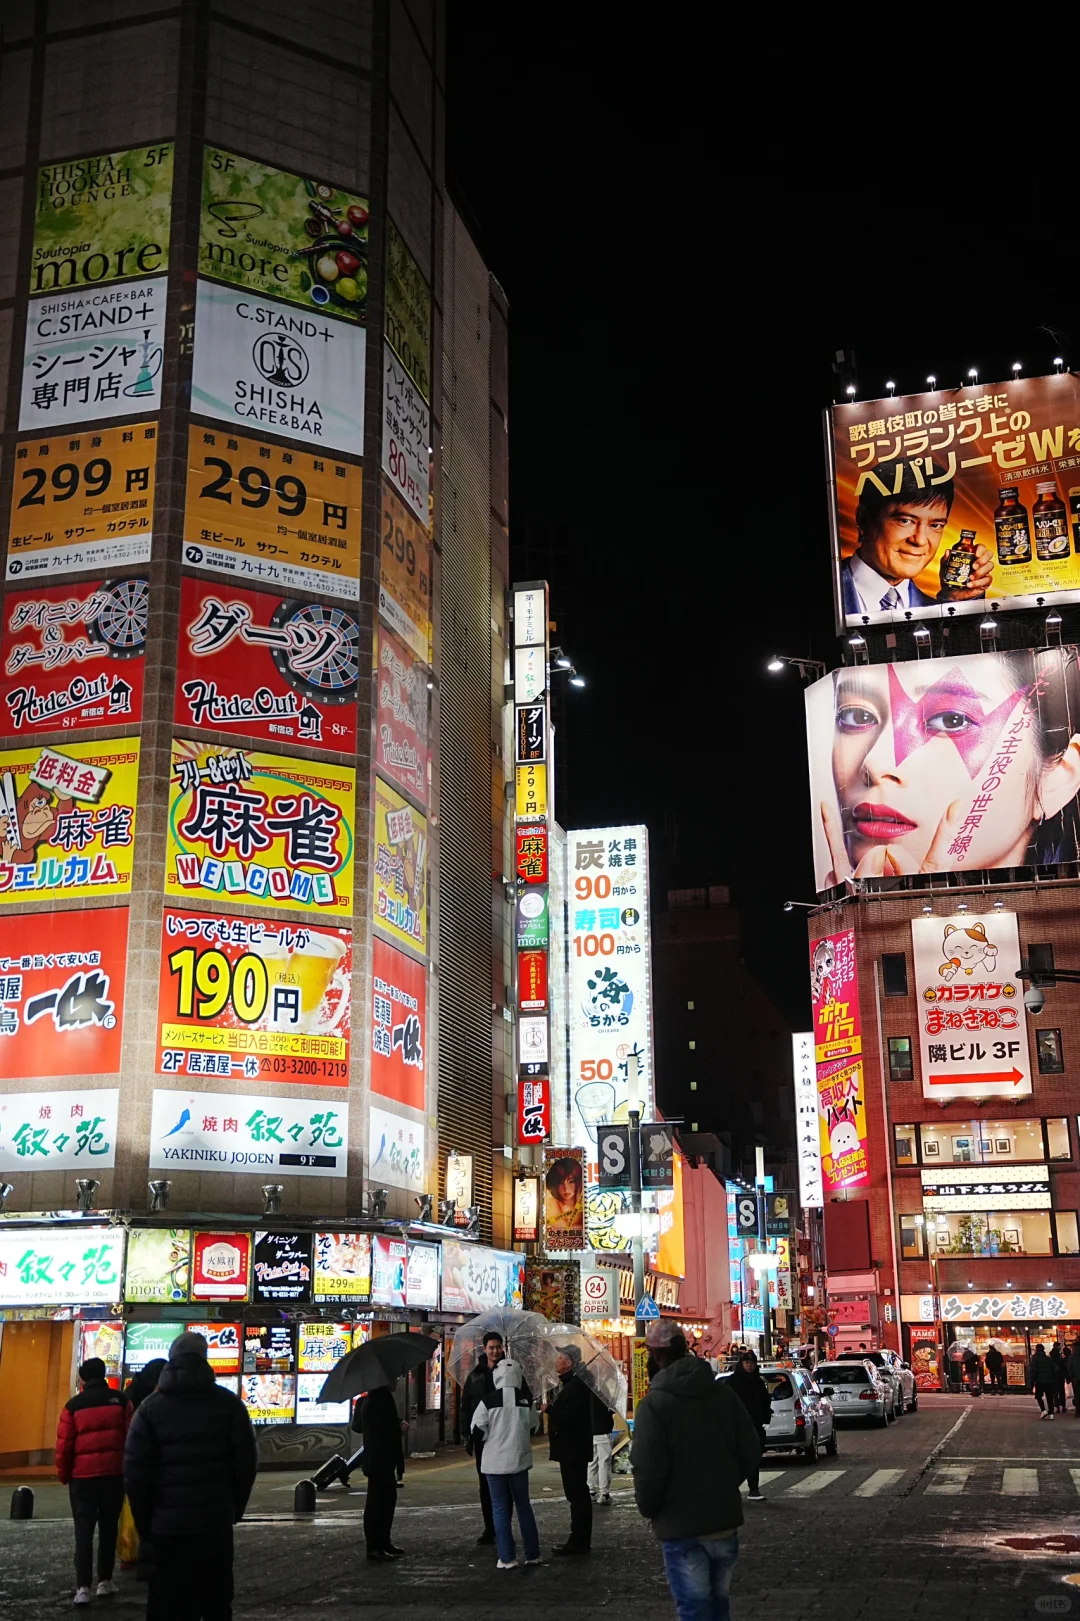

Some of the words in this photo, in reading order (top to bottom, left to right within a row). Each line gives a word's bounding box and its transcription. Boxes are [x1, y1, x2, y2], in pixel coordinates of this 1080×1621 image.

[41, 156, 115, 184] SHISHA
[144, 147, 169, 167] 5F
[210, 154, 235, 173] 5F
[39, 183, 131, 212] LOUNGE
[40, 168, 131, 198] HOOKAH
[34, 241, 90, 260] Suutopia
[245, 233, 290, 255] Suutopia
[31, 243, 162, 292] more
[206, 242, 289, 282] more
[37, 302, 154, 337] C.STAND+
[236, 303, 334, 343] C.STAND+
[32, 346, 136, 379] シーシャ
[30, 373, 123, 410] 専門店
[236, 381, 323, 419] SHISHA
[387, 363, 427, 428] ハイボール
[234, 402, 323, 436] CAFE&BAR
[387, 382, 428, 450] レモンサワー
[848, 393, 1008, 442] 歌舞伎町の皆さまに
[122, 428, 155, 443] 料理
[850, 410, 1031, 468] ワンランク上の
[204, 433, 238, 451] 焼鳥
[259, 447, 293, 464] 刺身
[313, 460, 346, 478] 料理
[1005, 465, 1049, 481] 清涼飲料水
[12, 533, 53, 547] 生ビール
[65, 527, 95, 538] サワー
[107, 518, 148, 532] カクテル
[277, 525, 347, 549] 均一個室居酒屋
[52, 553, 83, 566] 九十九
[188, 548, 201, 561] 7F
[201, 530, 245, 547] 生ビール
[257, 542, 288, 555] サワー
[300, 552, 341, 569] カクテル
[11, 563, 21, 572] 7F
[241, 560, 279, 578] 九十九
[304, 580, 356, 597] 03-6302-1914
[11, 593, 109, 630] ダイニング
[190, 599, 341, 669] ダーツ
[6, 640, 108, 672] ダーツバー
[62, 717, 77, 727] 8F
[332, 724, 348, 735] 8F
[528, 708, 542, 748] ダーツ
[36, 755, 96, 796] 低料金
[947, 663, 1059, 862] わたしが主役の世界線。
[50, 808, 131, 849] 麻雀
[184, 786, 338, 865] 麻雀
[375, 843, 404, 897] 麻雀
[518, 837, 545, 877] 麻雀
[575, 840, 605, 871] 炭
[0, 855, 117, 889] ウェルカム
[178, 858, 328, 898] WELCOME
[517, 877, 525, 885] 6F
[517, 889, 525, 897] 5F
[378, 888, 422, 943] ウェルカム
[574, 907, 620, 931] 寿司
[167, 916, 310, 949] いつでも生ビールが
[517, 936, 548, 947] more
[28, 972, 111, 1027] 一休
[587, 967, 630, 1004] 海
[937, 983, 1002, 1002] カラオケ
[589, 1013, 629, 1027] ちから
[819, 997, 849, 1024] ポケ
[926, 1006, 1019, 1034] まねきねこ
[393, 1014, 422, 1065] 一休
[825, 1016, 854, 1041] パラ
[163, 1052, 184, 1070] 2F
[189, 1053, 258, 1075] 居酒屋一休
[274, 1060, 347, 1077] 03-3200-1219
[928, 1042, 986, 1063] 隣ビル
[992, 1041, 1020, 1059] 3F
[528, 1064, 540, 1073] 3F
[821, 1076, 859, 1108] 高収入
[39, 1104, 83, 1119] 焼肉
[202, 1116, 238, 1132] 焼肉
[523, 1104, 544, 1137] 一休
[827, 1096, 862, 1126] バイト
[12, 1117, 109, 1156] 叙々苑
[245, 1110, 343, 1147] 叙々苑
[163, 1148, 227, 1161] YAKINIKU
[231, 1152, 274, 1165] JOJOEN
[300, 1155, 316, 1166] 9F
[940, 1184, 1048, 1194] 山下本気うどん
[16, 1244, 118, 1285] 叙々苑
[317, 1237, 331, 1270] 九十九
[130, 1285, 166, 1295] more
[590, 1283, 601, 1293] 24
[209, 1327, 237, 1346] 一休
[306, 1325, 335, 1336] 低料金
[144, 1341, 171, 1350] mor
[302, 1339, 345, 1359] 麻雀
